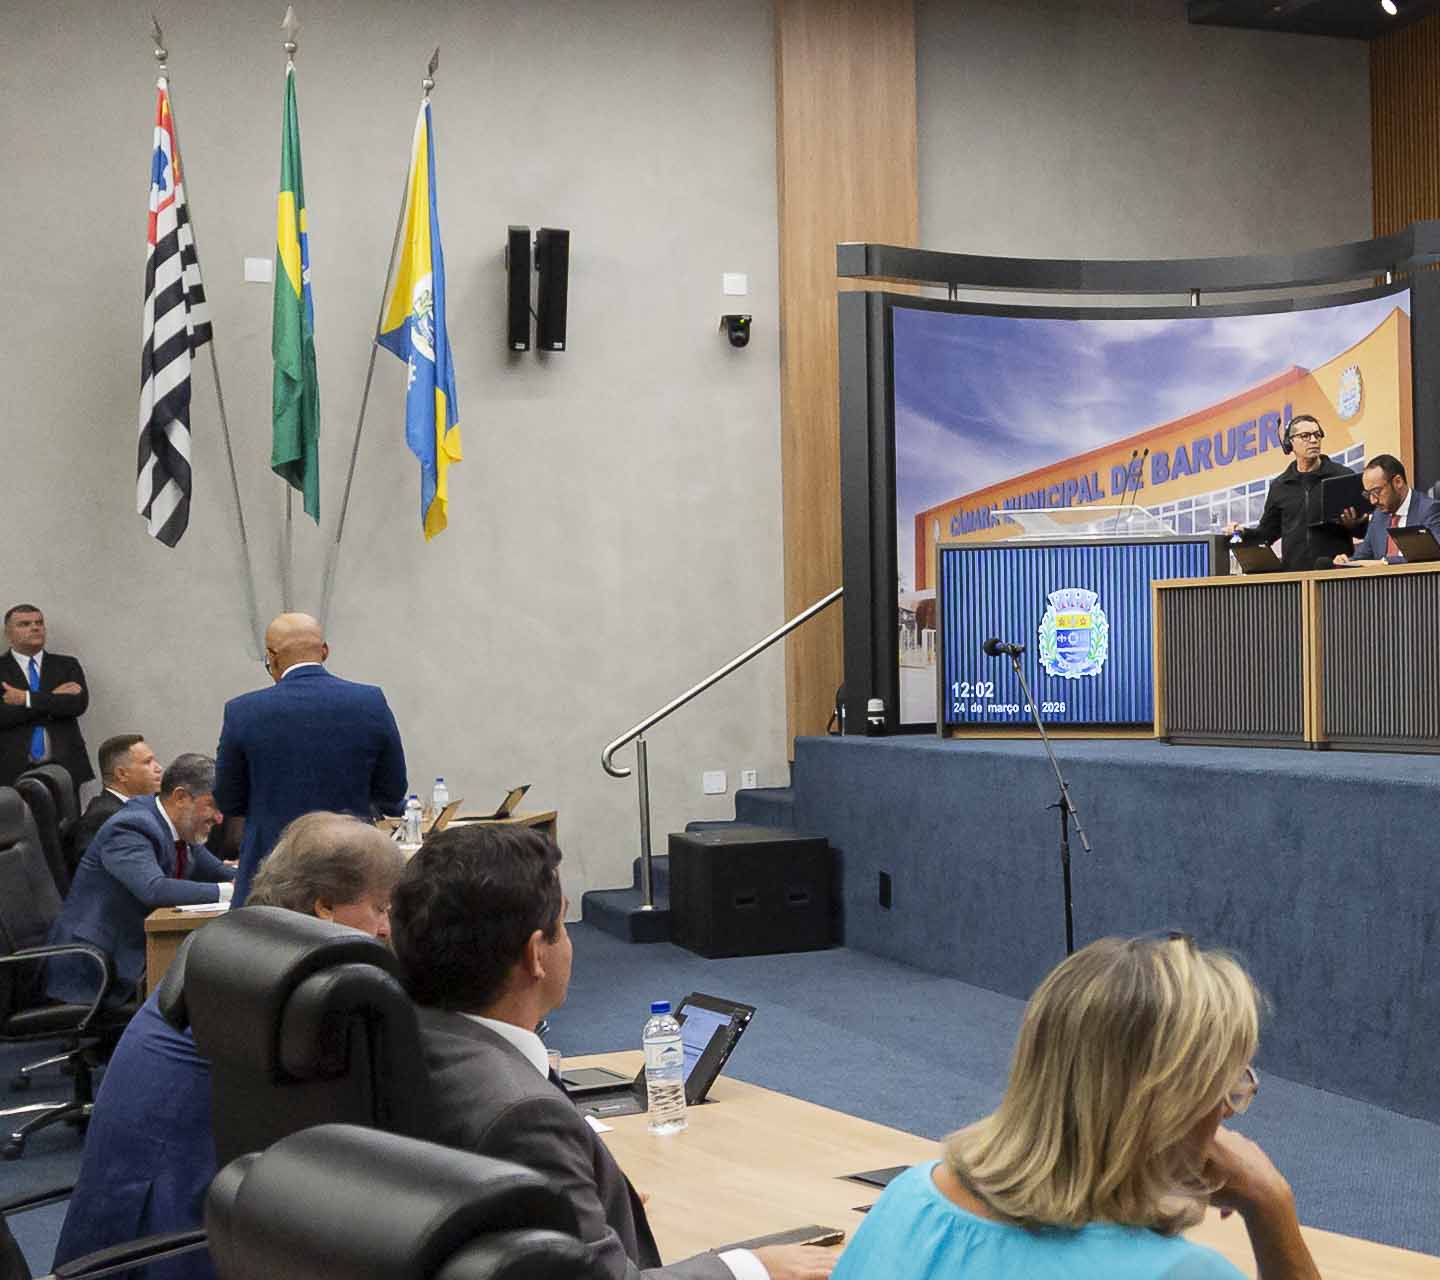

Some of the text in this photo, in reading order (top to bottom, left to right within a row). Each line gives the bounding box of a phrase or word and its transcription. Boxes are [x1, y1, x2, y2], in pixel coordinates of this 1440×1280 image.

[1002, 472, 1105, 516] MUNICIPAL
[1110, 460, 1144, 496] DE
[1151, 403, 1294, 486] BARUERI
[952, 682, 994, 698] 12:02
[954, 702, 1065, 714] 24 de março d 2026
